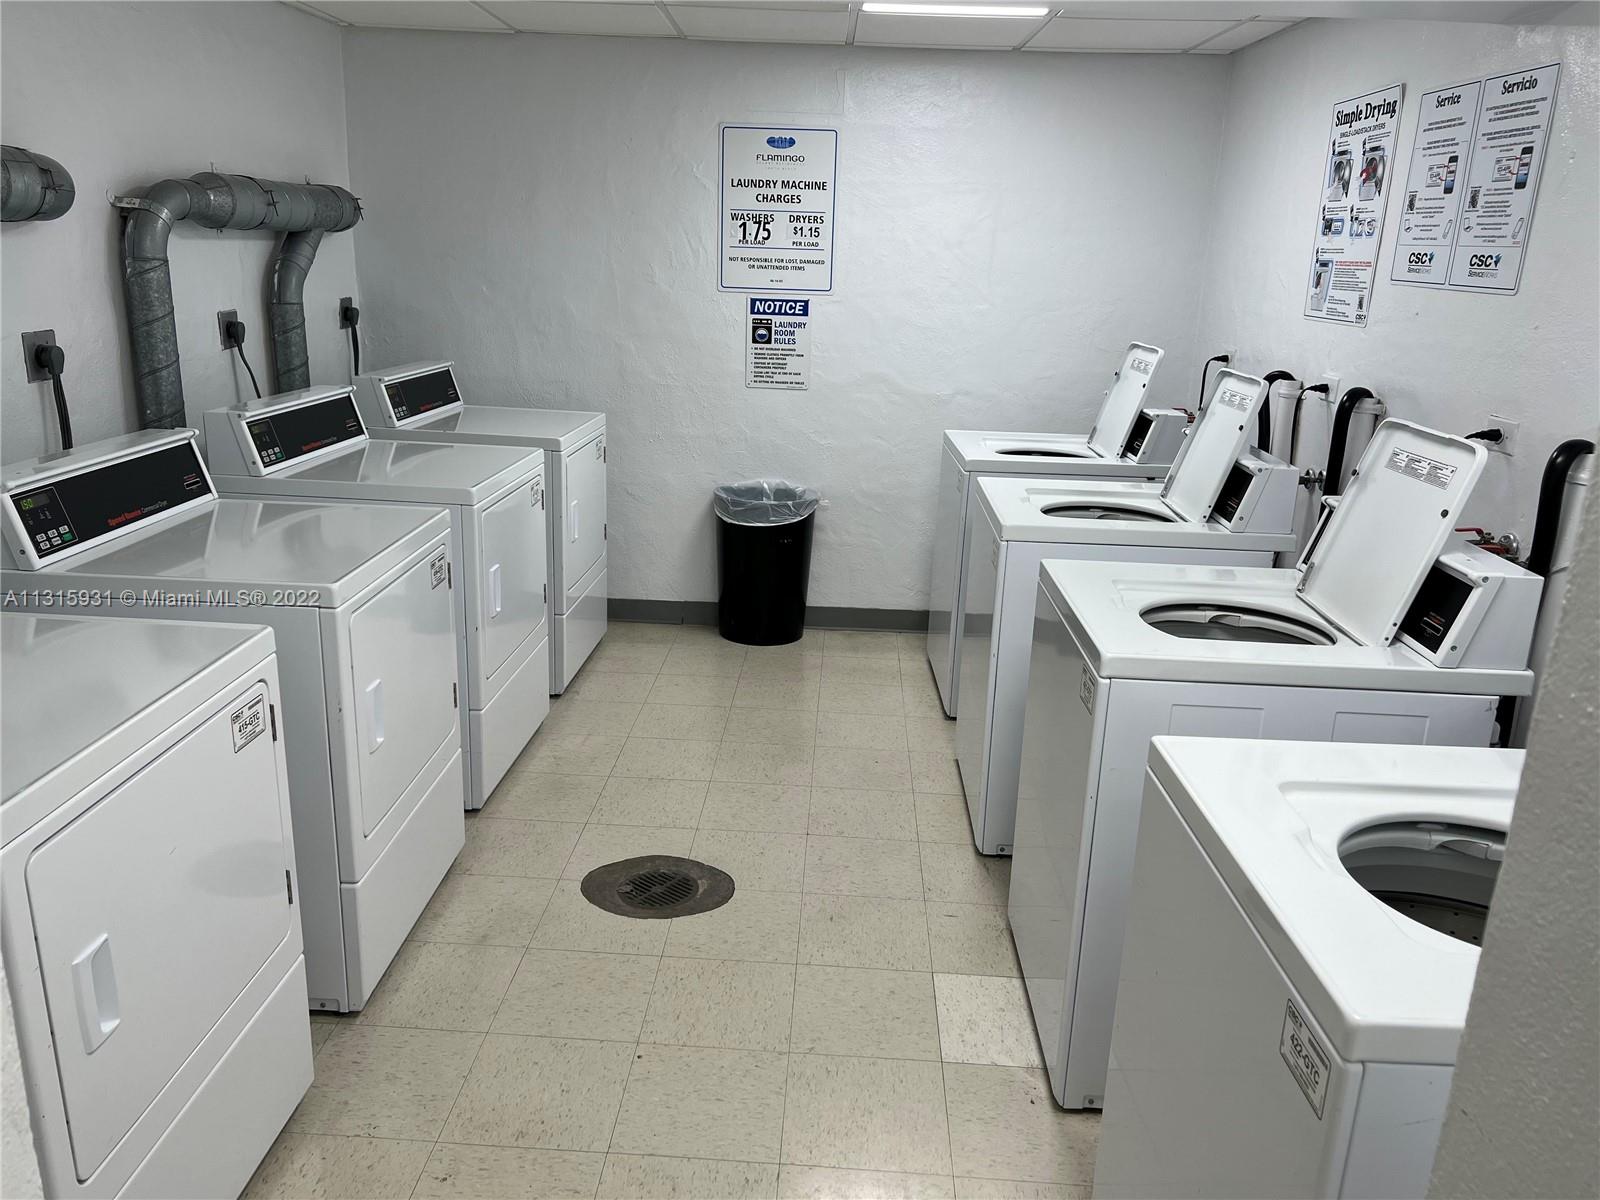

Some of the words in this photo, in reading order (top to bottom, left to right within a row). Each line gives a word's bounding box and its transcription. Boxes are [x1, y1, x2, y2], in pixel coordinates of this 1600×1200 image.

[1501, 75, 1538, 95] Servicio
[1435, 92, 1462, 108] Service
[1335, 104, 1363, 128] Simple
[1364, 98, 1398, 122] Drying
[731, 178, 778, 189] LAUNDRY
[781, 180, 827, 190] MACHINE
[756, 193, 802, 204] CHARGES
[730, 212, 775, 222] WASHERS
[789, 215, 824, 224] DRYERS
[739, 220, 771, 240] 1.75
[793, 226, 820, 237] $1.15
[1408, 252, 1428, 264] CSC
[1469, 254, 1493, 267] CSC
[754, 301, 805, 314] NOTICE
[774, 321, 807, 329] LAUNDRY
[774, 329, 796, 337] ROOM
[774, 337, 797, 345] RULES
[1290, 1033, 1320, 1085] 422-GTC
